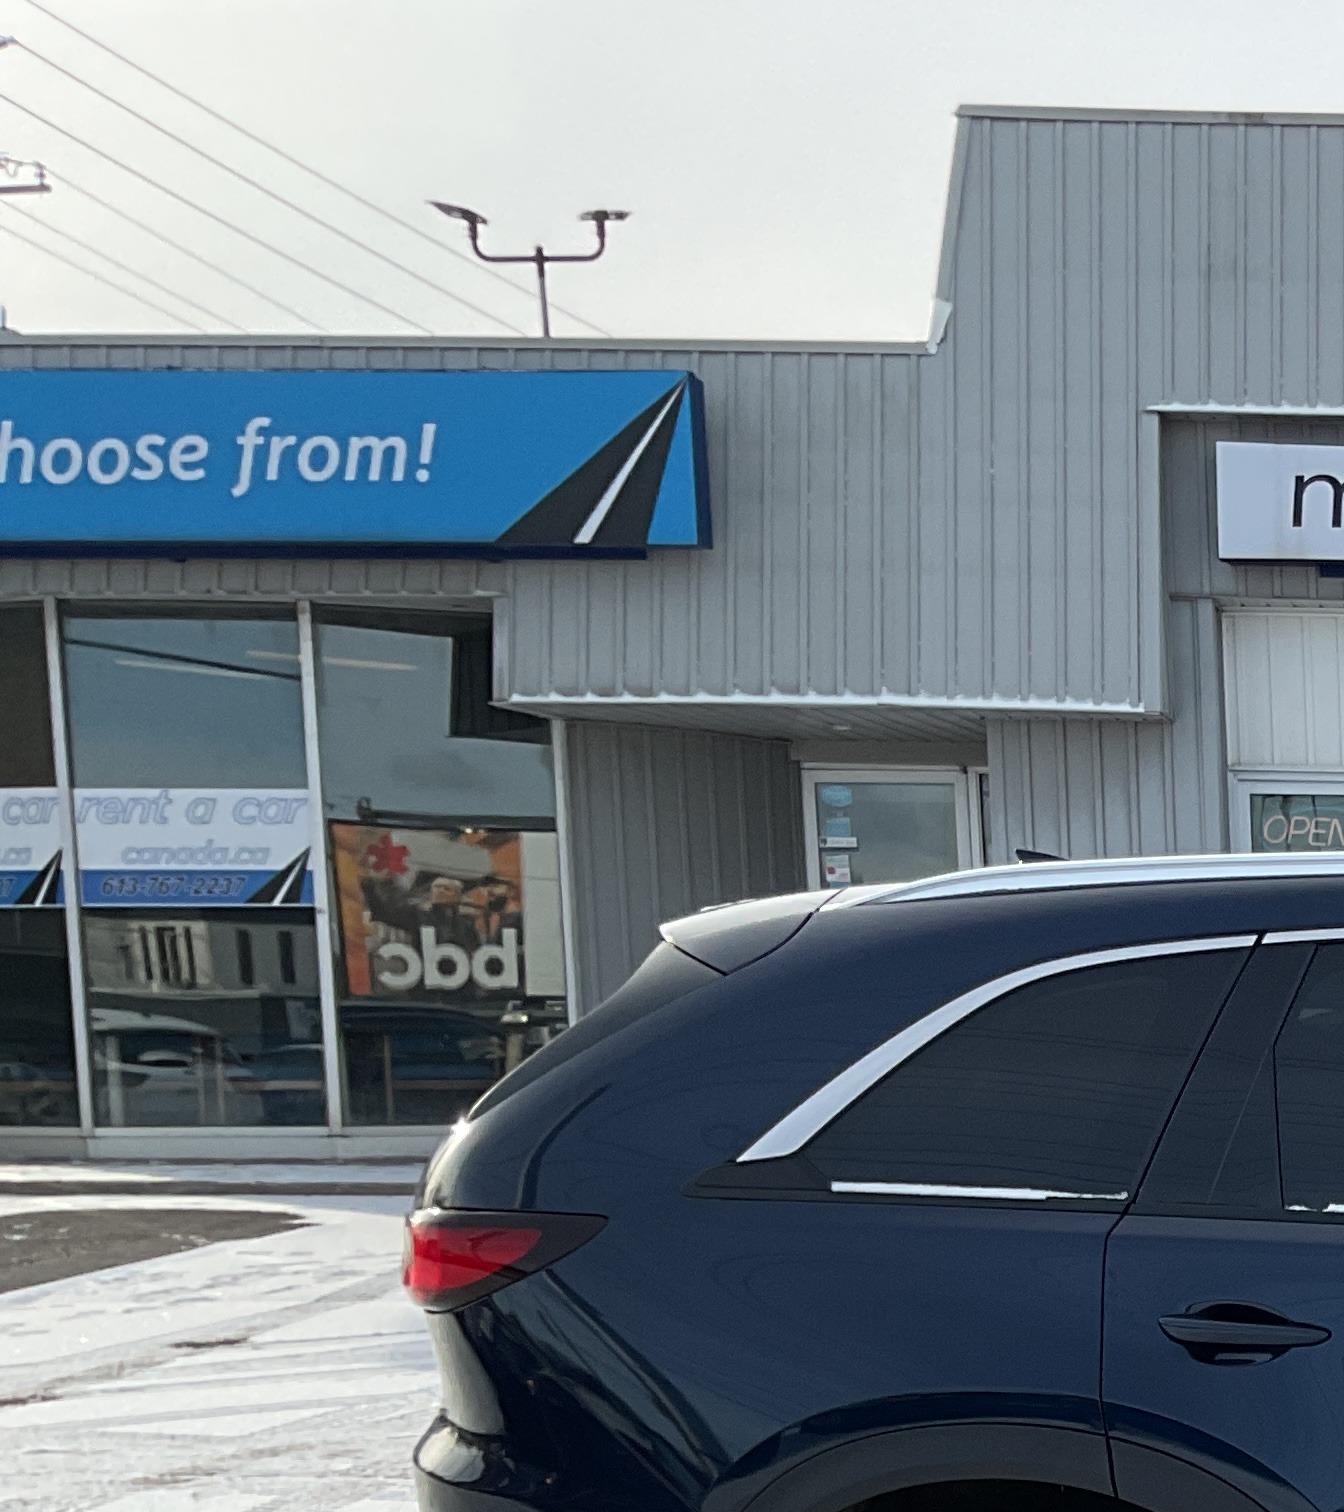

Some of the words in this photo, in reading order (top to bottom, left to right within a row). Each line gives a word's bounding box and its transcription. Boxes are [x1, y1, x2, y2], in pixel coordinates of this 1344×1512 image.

[0, 420, 209, 485] hoose
[230, 416, 437, 498] from!
[76, 788, 173, 825] rent
[185, 796, 217, 825] a
[231, 796, 309, 825] car
[120, 838, 271, 866] canada.ca
